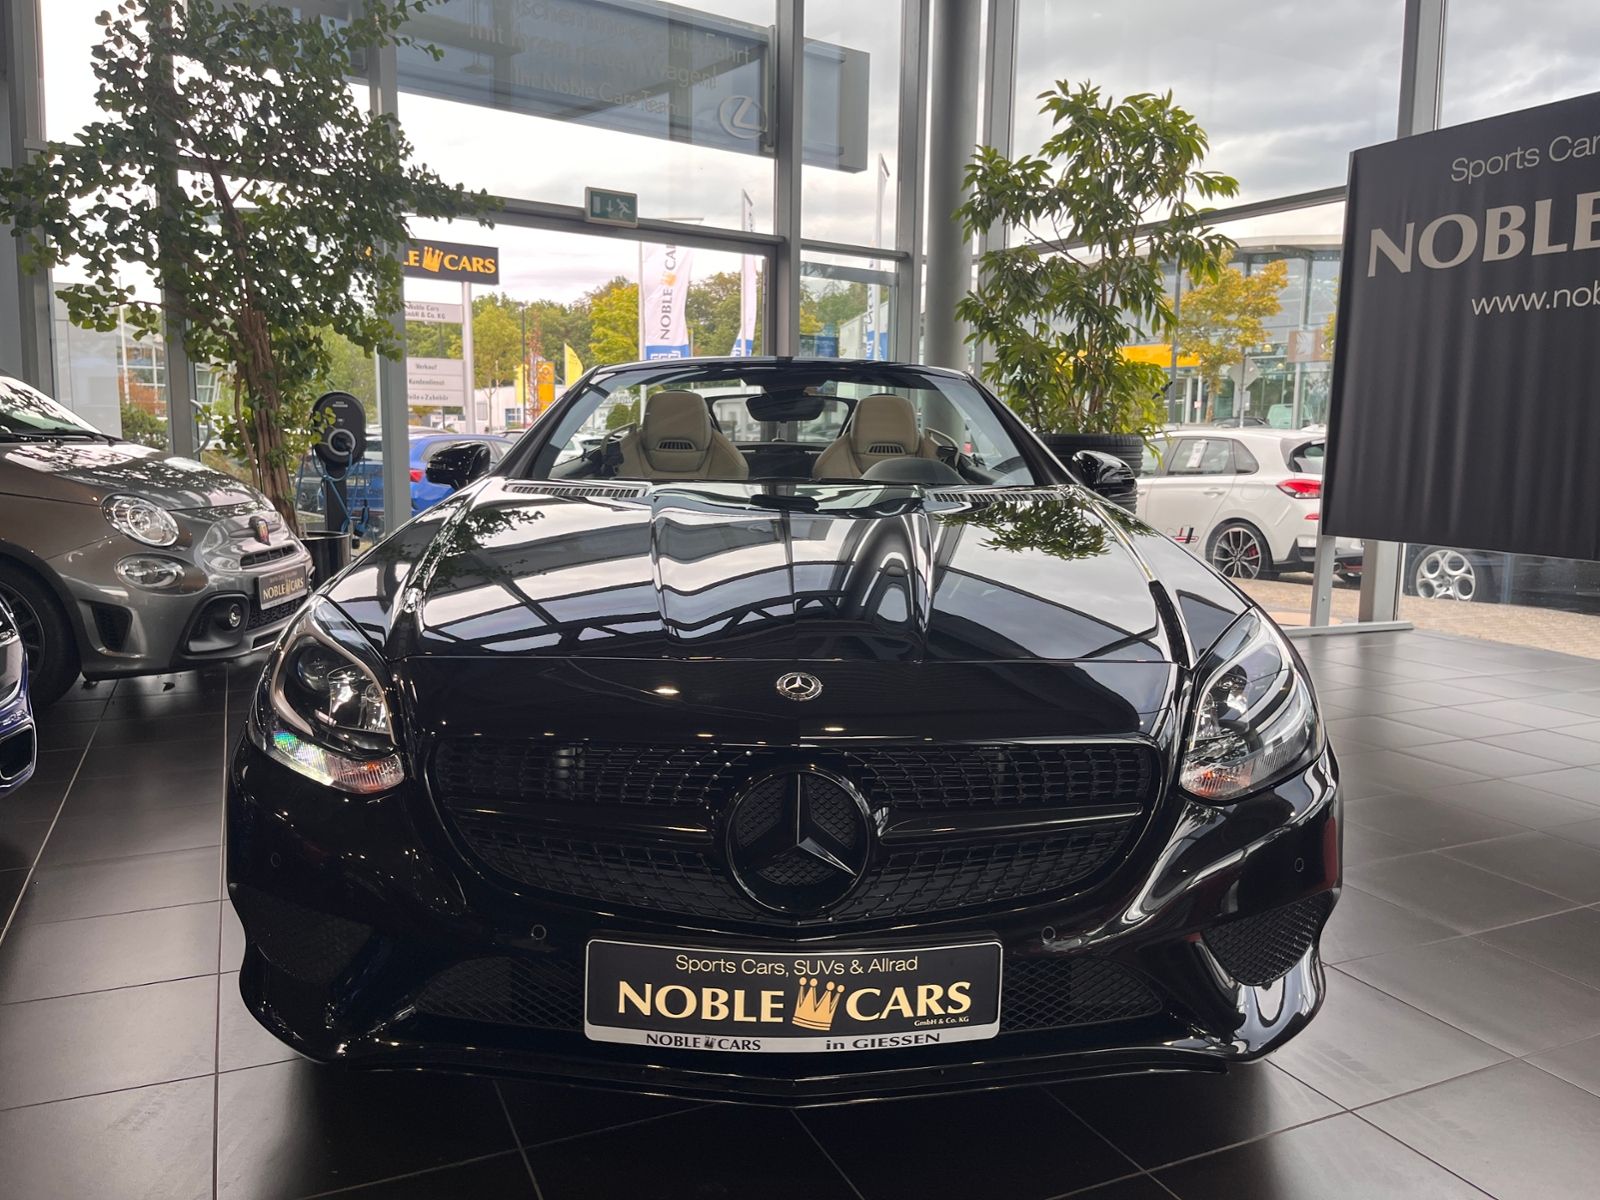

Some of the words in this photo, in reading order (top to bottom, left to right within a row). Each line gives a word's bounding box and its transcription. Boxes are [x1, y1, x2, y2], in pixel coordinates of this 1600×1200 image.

[705, 32, 750, 64] Fahrt
[542, 71, 594, 97] Noble
[598, 81, 638, 108] Cars
[640, 90, 681, 115] Team
[1451, 147, 1540, 184] Sports
[1367, 191, 1600, 278] NOBLE
[443, 254, 497, 274] CARS
[660, 288, 674, 340] NOBLE
[263, 583, 286, 600] NOBLE
[290, 577, 304, 592] CARS
[675, 954, 737, 975] Sports
[741, 958, 789, 978] Cars,
[793, 959, 845, 976] SUVs
[849, 959, 864, 975] &
[867, 955, 918, 973] Allrad
[617, 980, 785, 1023] NOBLE
[845, 981, 972, 1022] CARS
[913, 1019, 937, 1027] GmbH
[646, 1033, 701, 1049] NOBLE
[717, 1038, 761, 1051] CARS
[825, 1039, 845, 1051] in
[852, 1032, 941, 1050] GIESSEN
